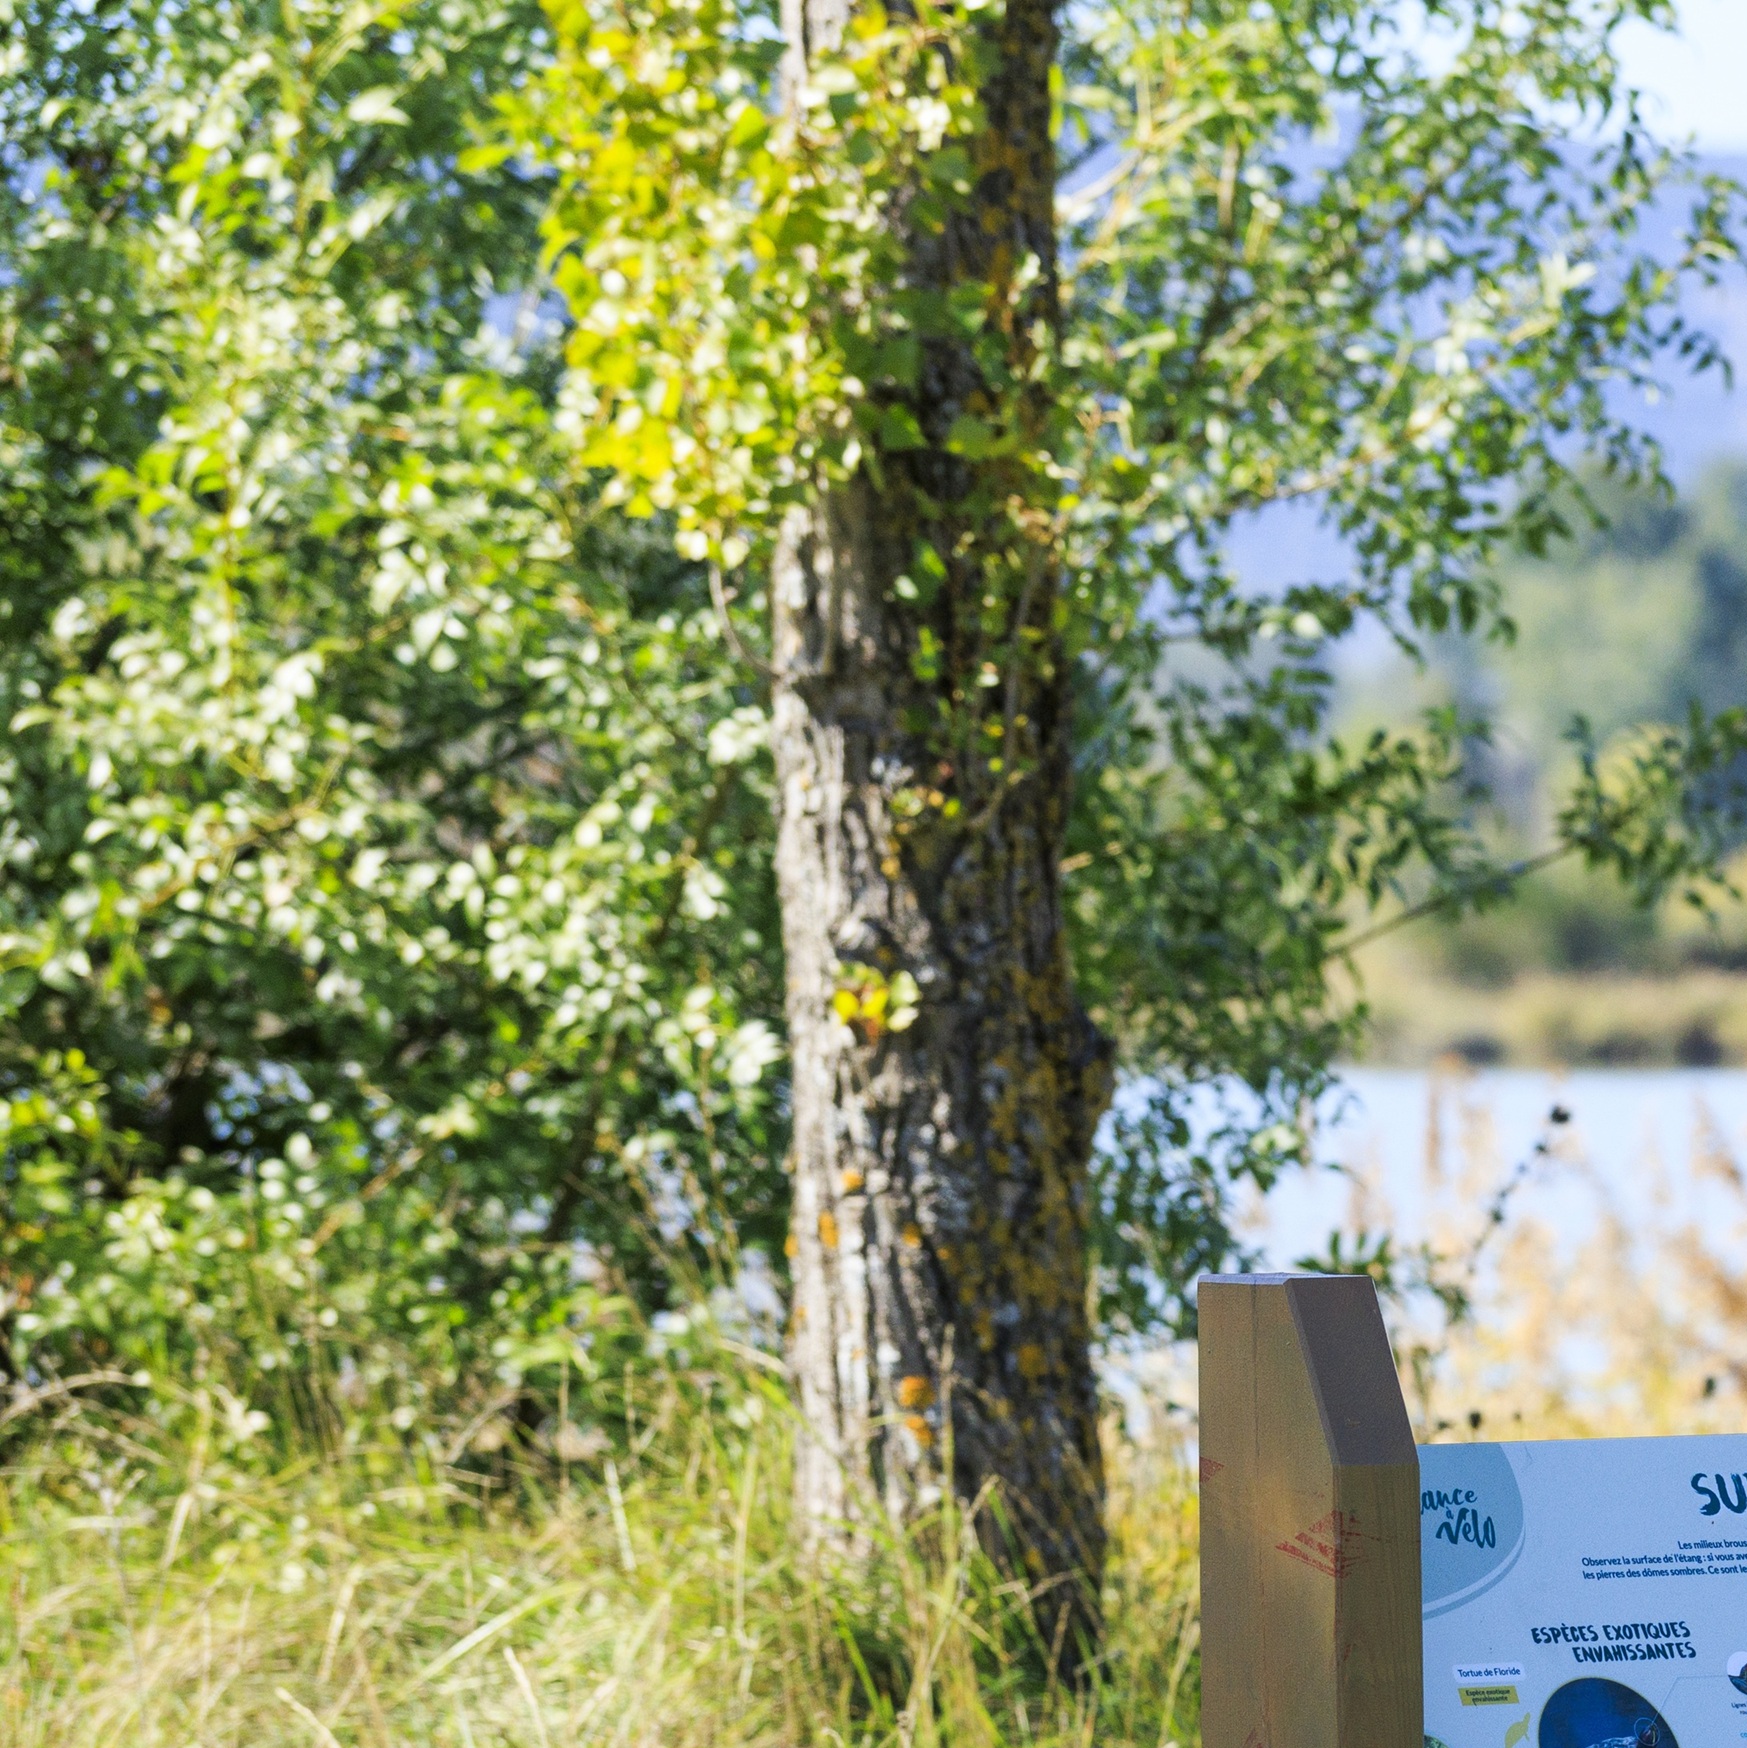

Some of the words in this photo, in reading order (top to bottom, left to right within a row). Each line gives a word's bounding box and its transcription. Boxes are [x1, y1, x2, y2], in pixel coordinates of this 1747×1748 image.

[1677, 1540, 1692, 1549] Les
[1693, 1539, 1723, 1548] milieux
[1582, 1570, 1595, 1579] les
[1595, 1569, 1625, 1580] pierres
[1625, 1568, 1641, 1577] des
[1641, 1568, 1669, 1576] dômes
[1669, 1566, 1707, 1575] sombres.
[1707, 1565, 1719, 1574] Ce
[1720, 1565, 1738, 1573] sont
[1531, 1623, 1598, 1643] ESPÈCES
[1602, 1621, 1690, 1640] EXOTIQUES
[1572, 1642, 1695, 1662] ENVAHISSANTES
[1457, 1669, 1482, 1677] Tortue
[1483, 1668, 1493, 1676] de
[1493, 1667, 1520, 1675] Floride
